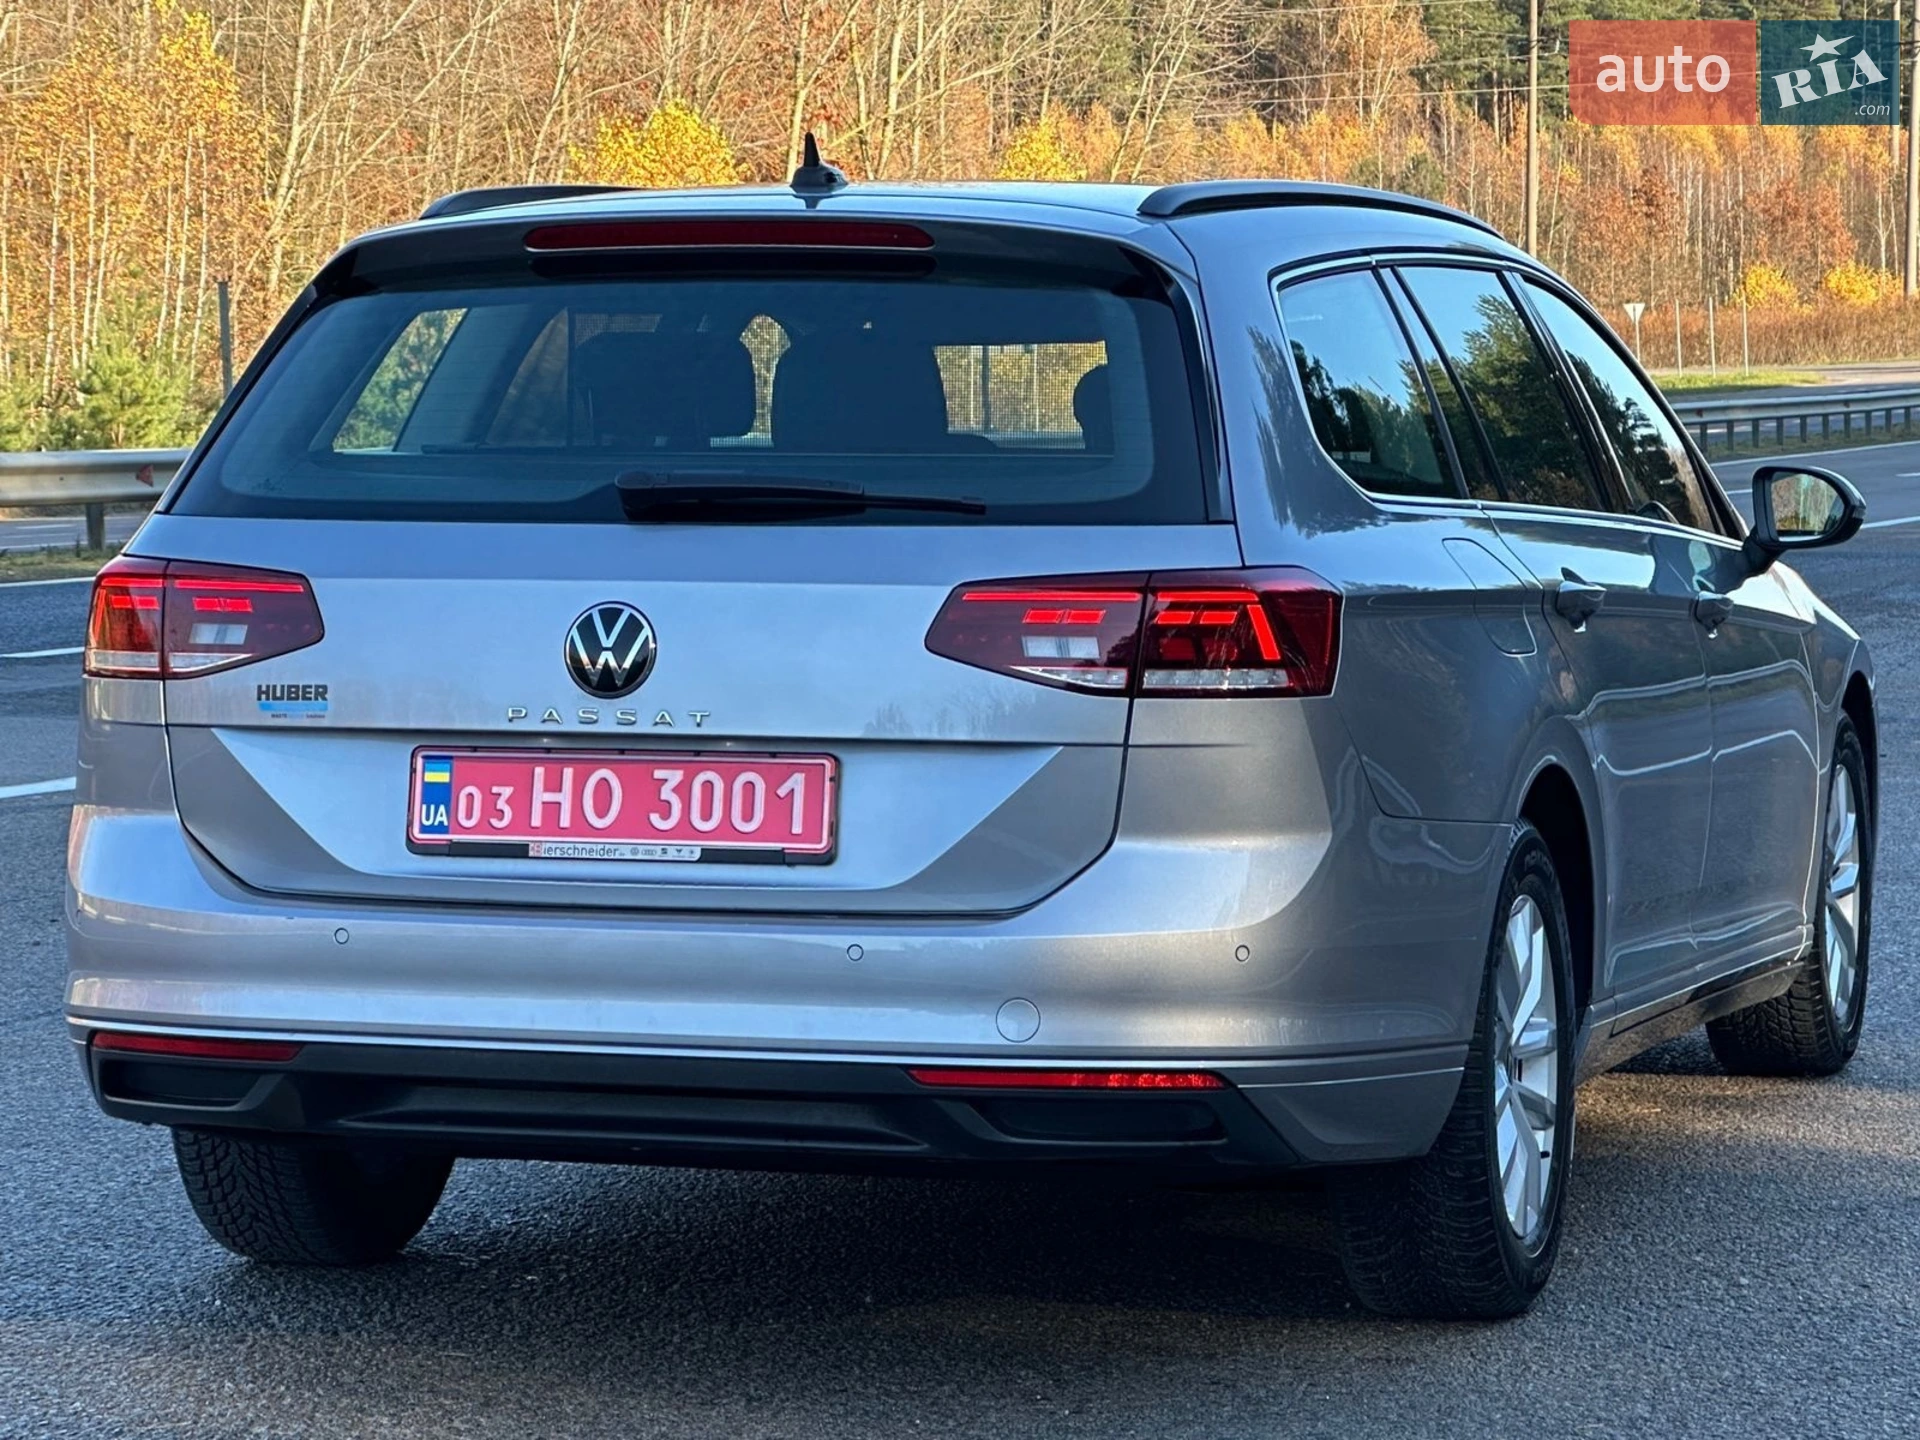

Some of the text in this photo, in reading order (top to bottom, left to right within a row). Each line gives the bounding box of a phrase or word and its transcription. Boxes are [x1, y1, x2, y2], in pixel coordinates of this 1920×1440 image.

[256, 684, 328, 702] HUBER
[507, 706, 711, 728] PASSAT
[457, 766, 806, 836] 03 HO 3001
[421, 804, 448, 826] UA
